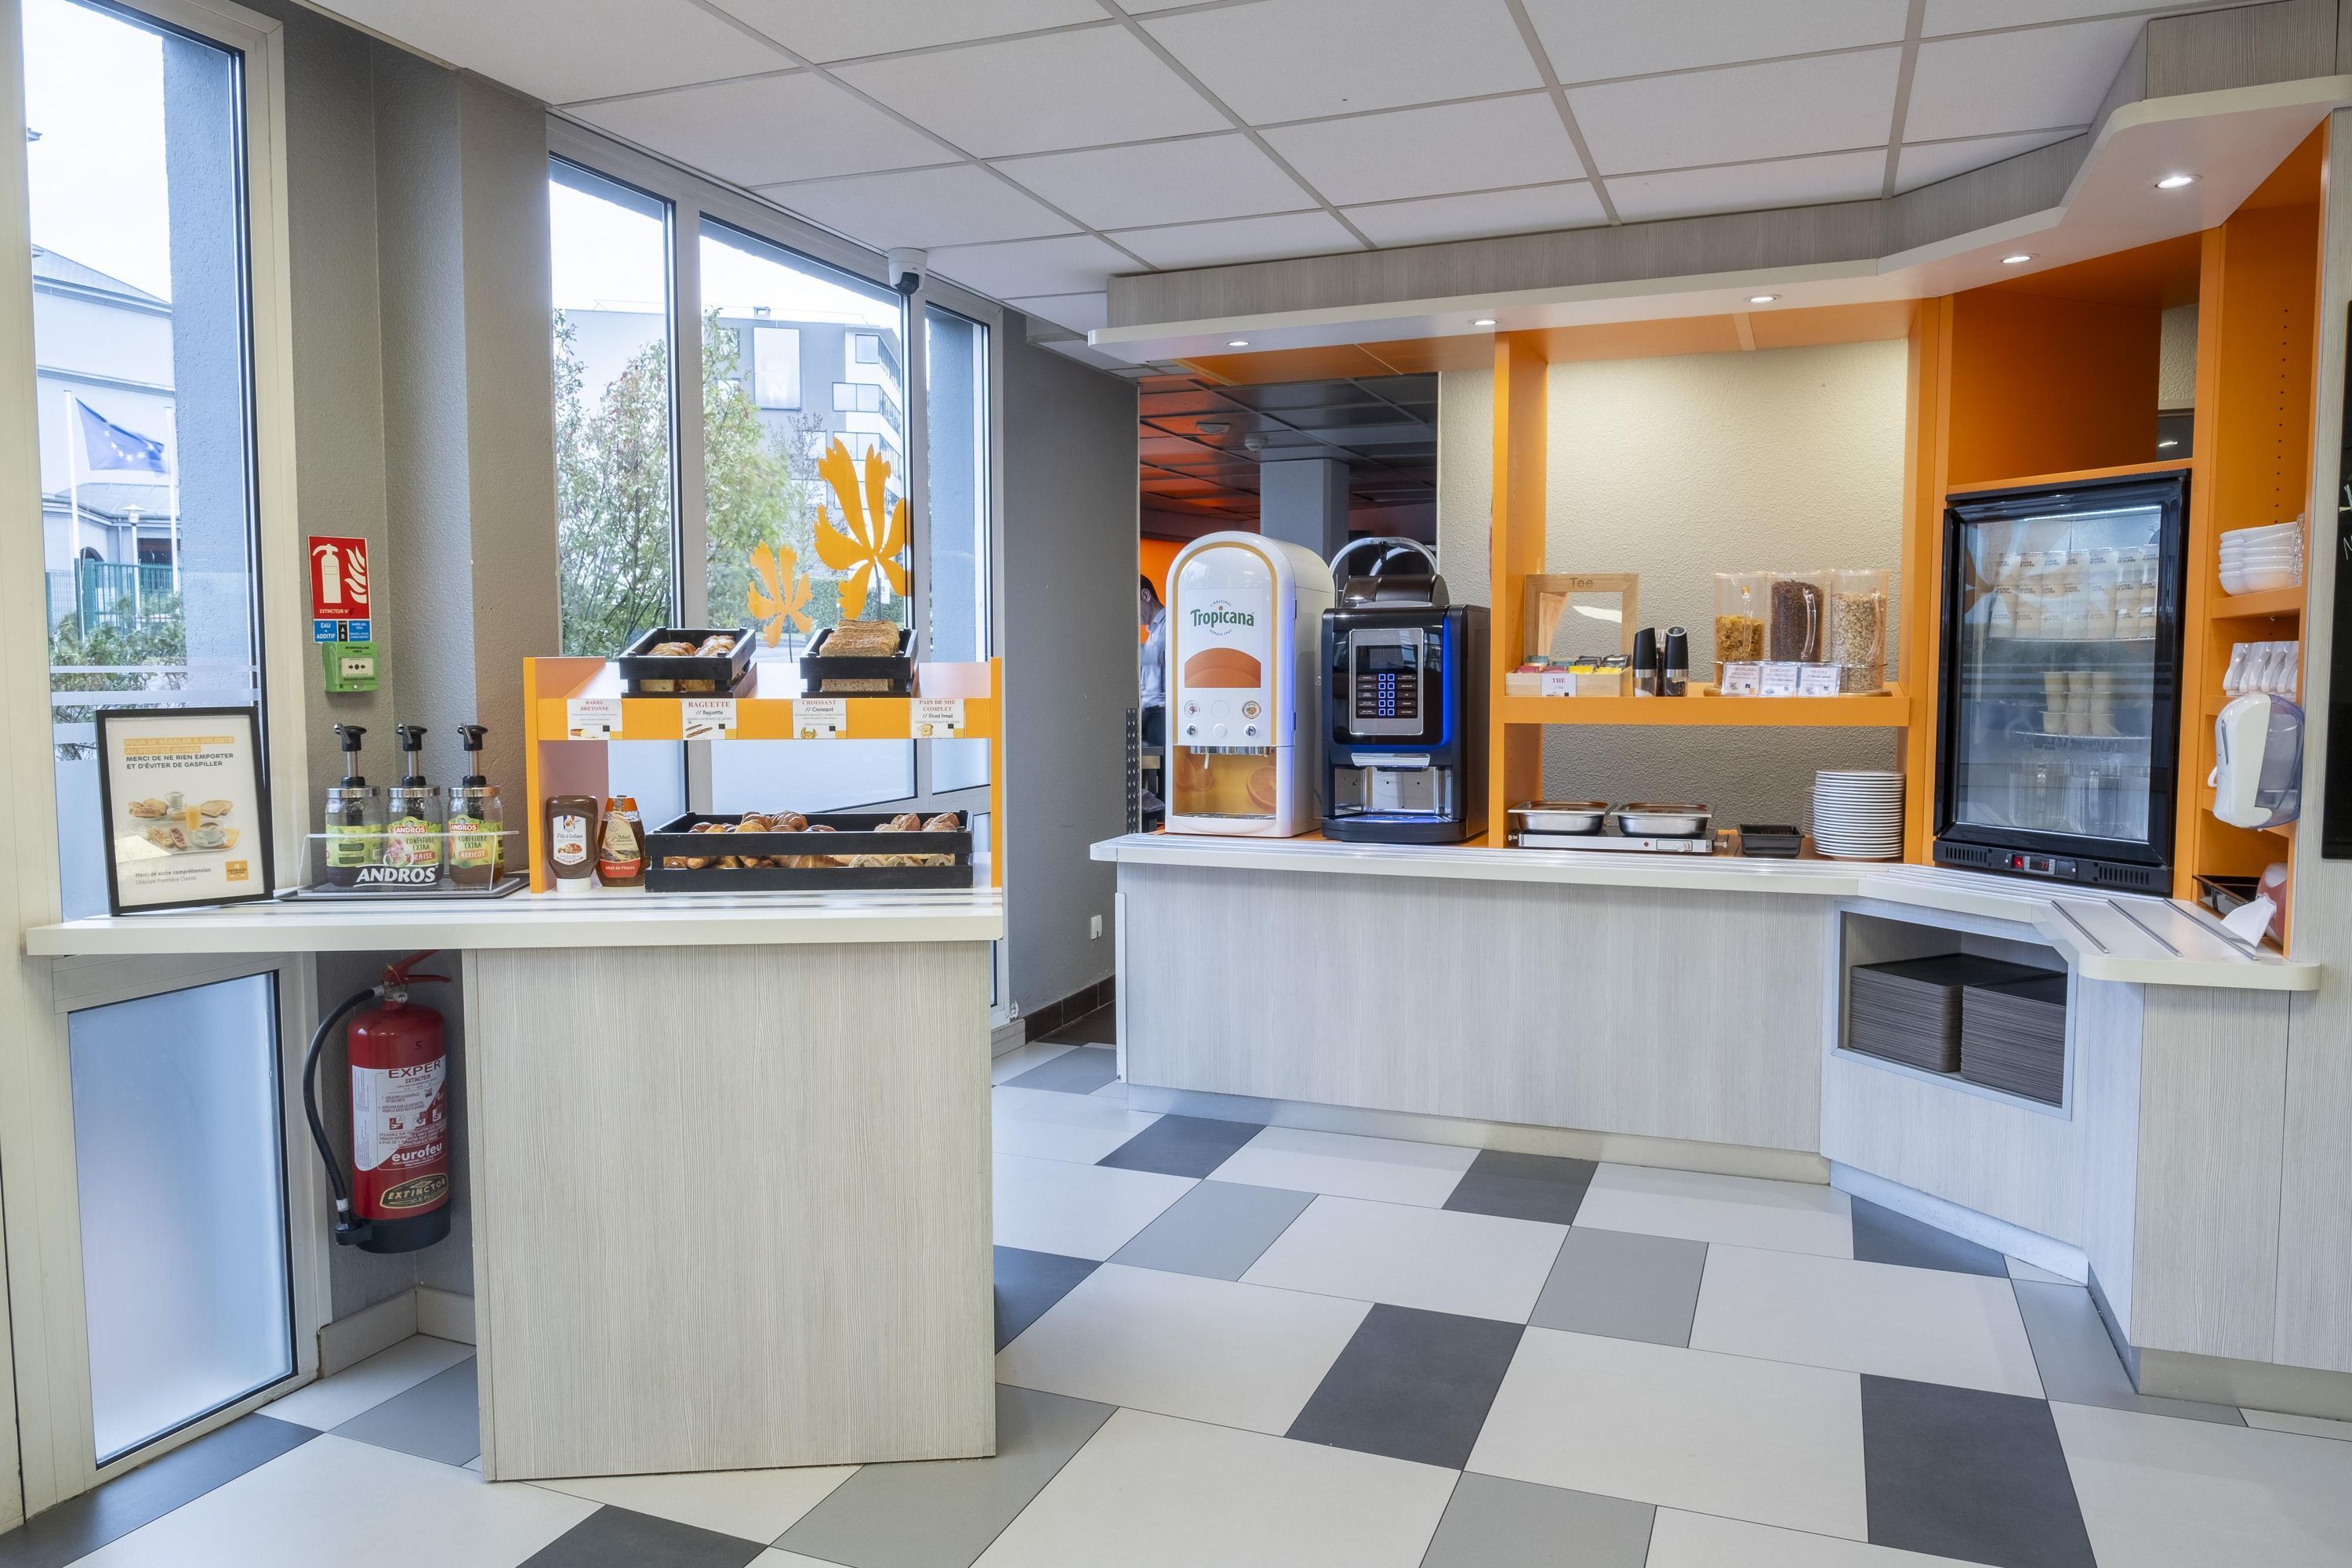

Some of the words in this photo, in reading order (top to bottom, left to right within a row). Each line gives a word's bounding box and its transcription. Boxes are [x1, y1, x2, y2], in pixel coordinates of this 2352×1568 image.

[1570, 577, 1593, 588] Tee
[1190, 606, 1254, 628] Tropicana
[460, 851, 485, 859] ABRICOT
[172, 867, 212, 876] compréhension
[356, 867, 436, 884] ANDROS
[389, 1060, 441, 1079] EXPER
[405, 1073, 431, 1083] EXTINCTEUR
[392, 1142, 442, 1162] eurofeu
[388, 1178, 446, 1200] EXTINCTOR
